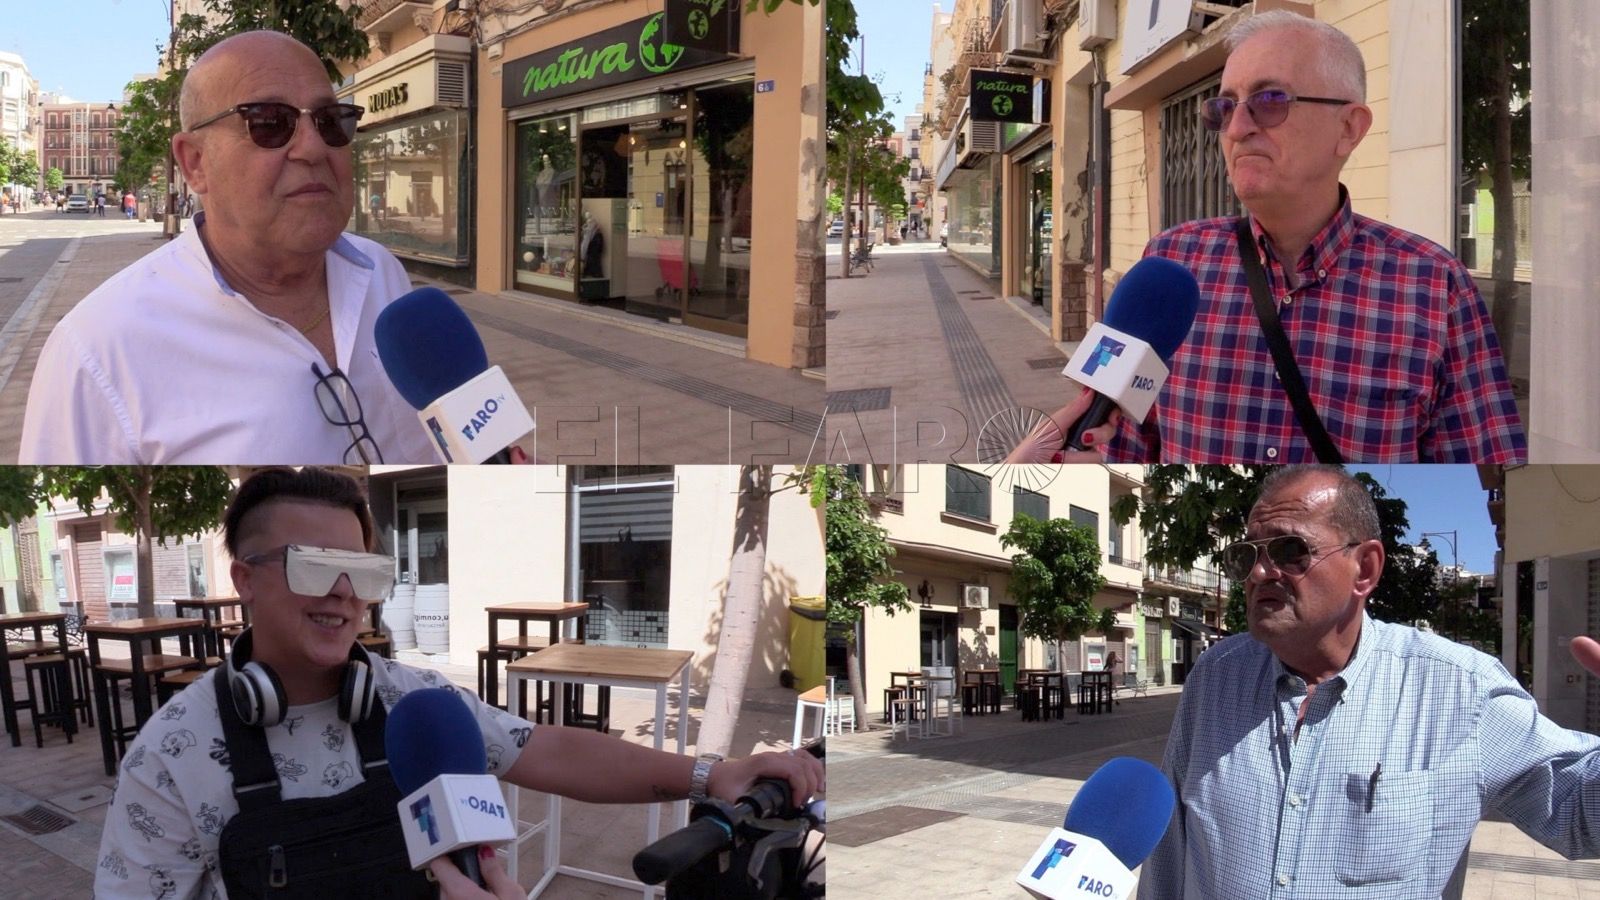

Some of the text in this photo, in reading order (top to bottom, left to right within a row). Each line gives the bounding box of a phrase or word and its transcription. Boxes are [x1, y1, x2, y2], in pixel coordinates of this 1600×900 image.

[523, 42, 636, 97] natura
[368, 83, 408, 113] MODAS
[976, 80, 1029, 94] natura
[1131, 375, 1154, 391] FARO
[462, 399, 498, 441] FARO
[1078, 875, 1113, 898] FARO
